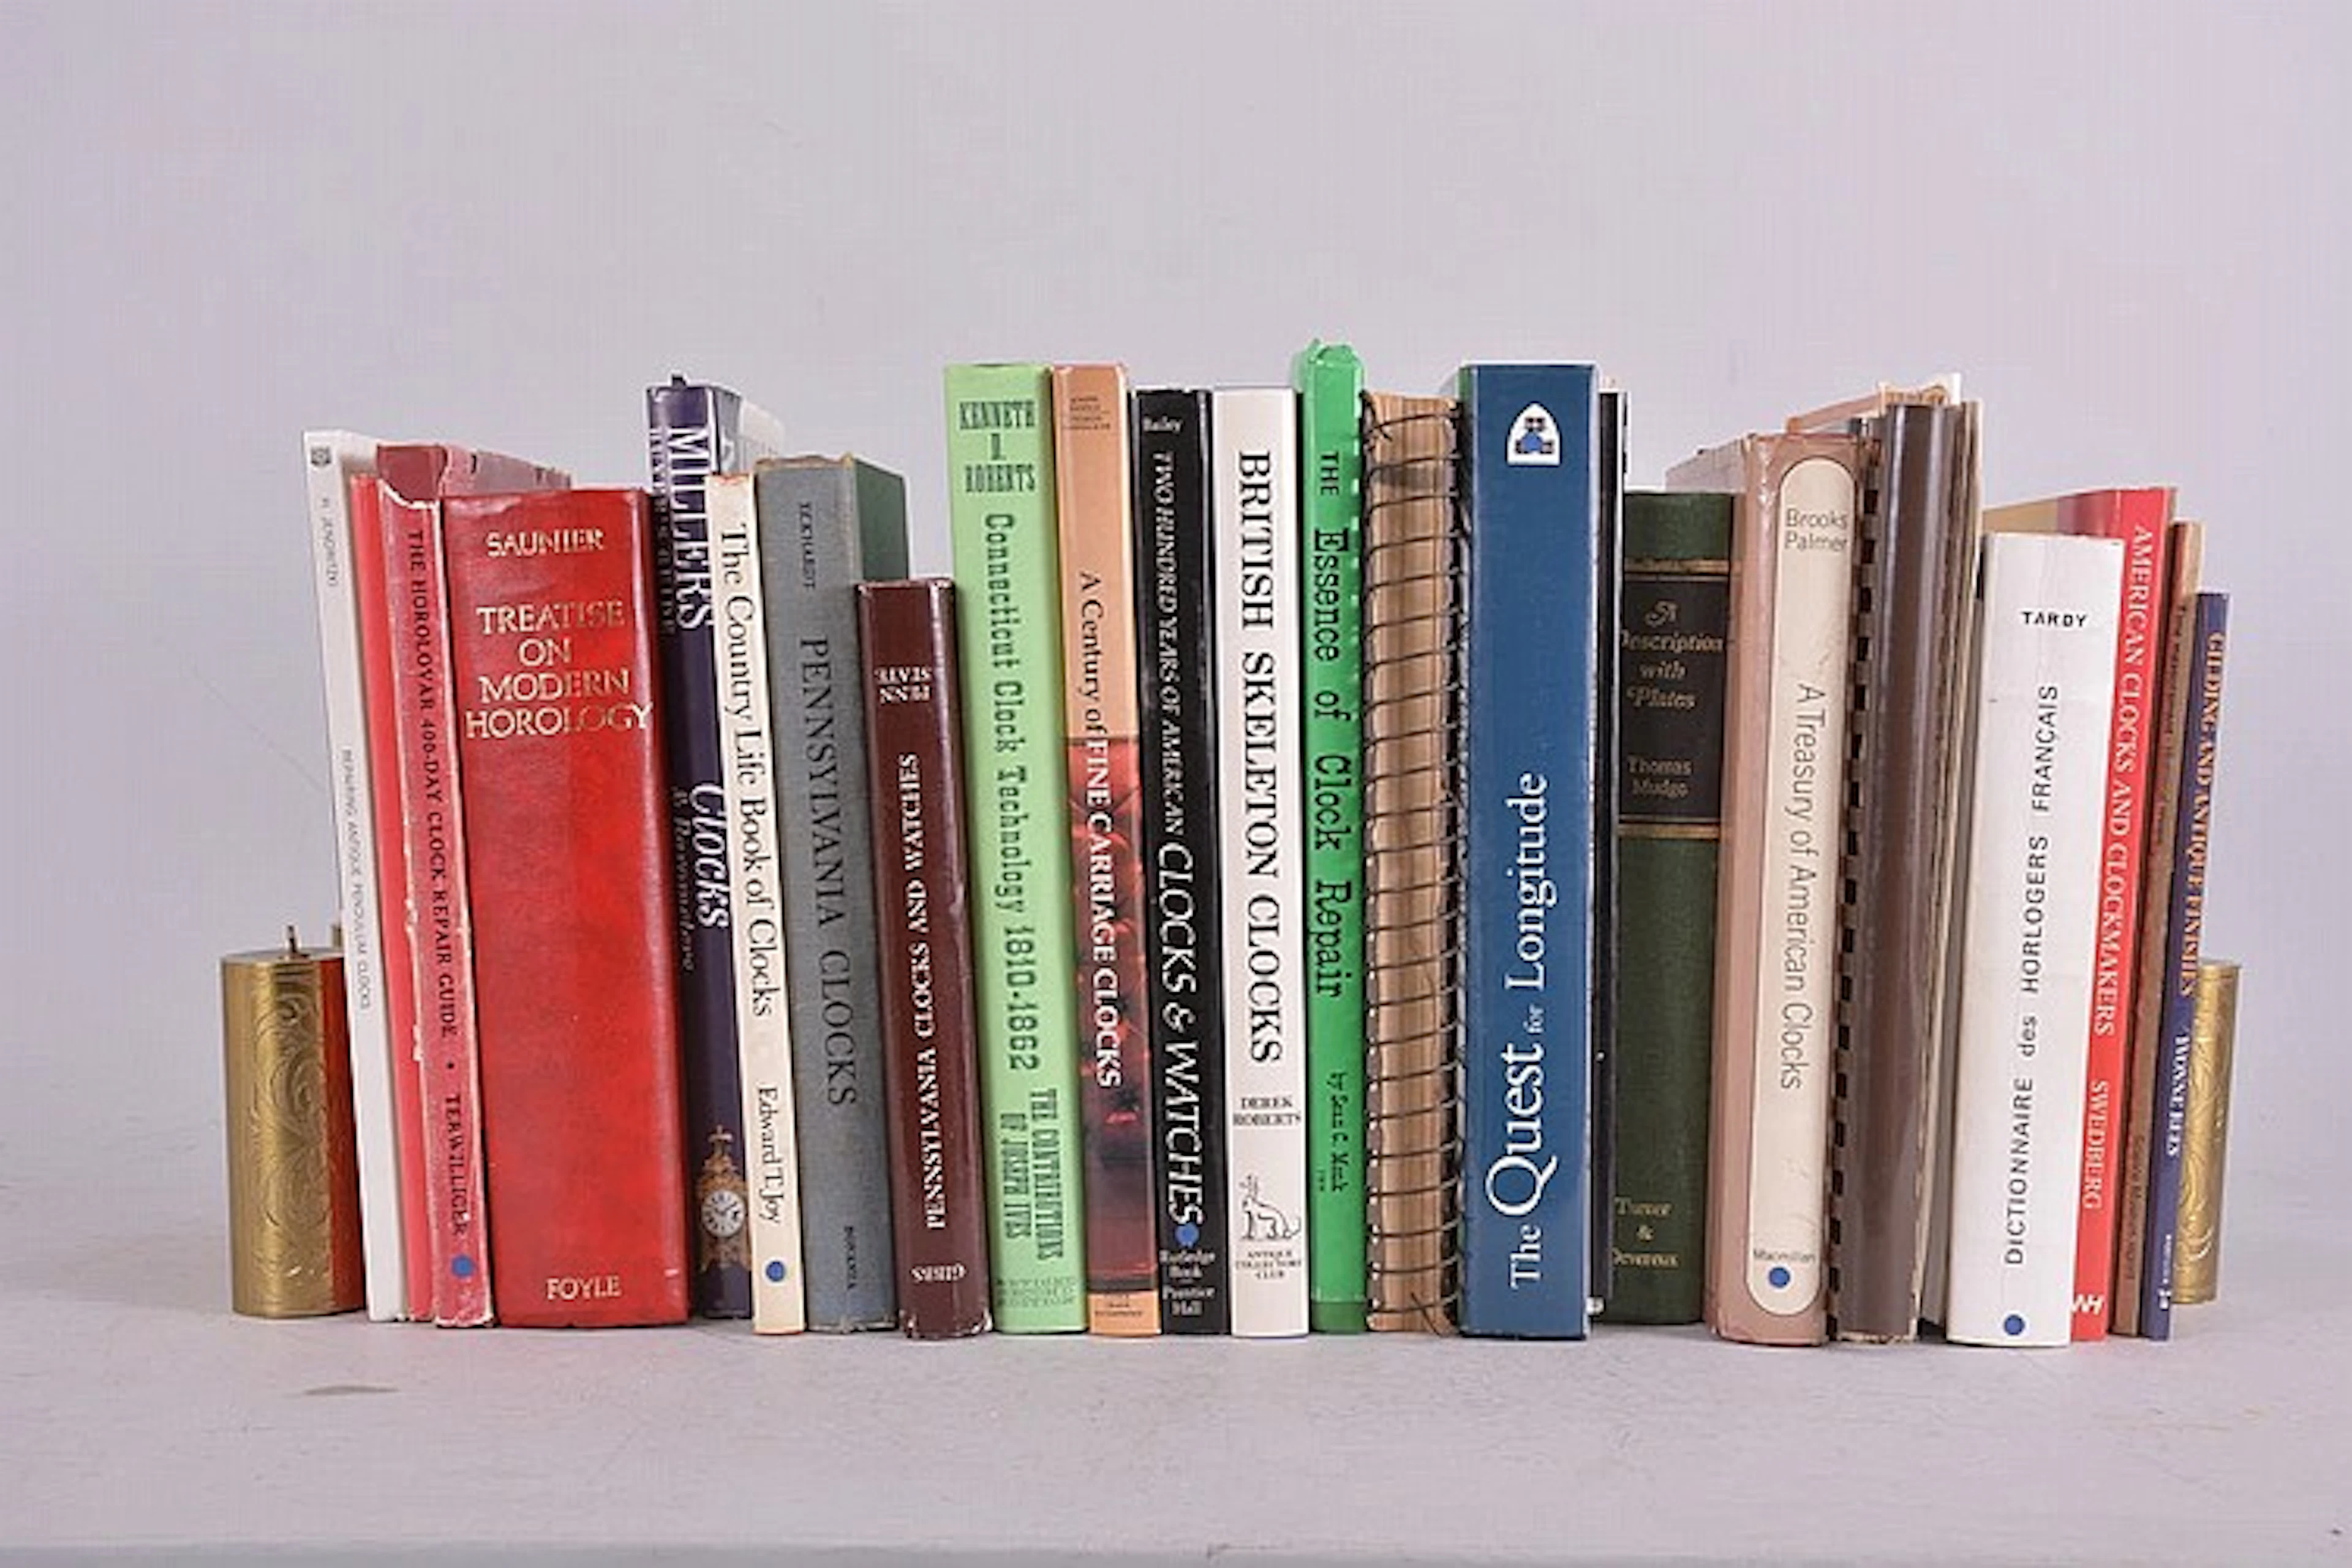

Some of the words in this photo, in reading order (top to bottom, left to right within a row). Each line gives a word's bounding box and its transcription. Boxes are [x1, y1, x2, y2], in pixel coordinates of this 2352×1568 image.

[965, 463, 1036, 492] ROBERTS
[1153, 451, 1175, 504] TWO
[1320, 451, 1340, 497] THE
[407, 529, 428, 571] THE
[486, 528, 605, 557] SAUNIER
[722, 523, 749, 584] The
[1238, 450, 1274, 631] BRITISH
[1785, 530, 1847, 552] Palmer
[1787, 507, 1848, 530] Brooks
[986, 513, 1022, 669] Connecticut
[1080, 571, 1104, 592] A
[1155, 507, 1178, 613] HUNDRED
[1314, 527, 1350, 663] Essence
[2123, 526, 2154, 666] AMERICAN
[410, 581, 437, 710] HOROLOVAR
[476, 600, 624, 635] TREATISE
[518, 638, 570, 666] ON
[1077, 598, 1105, 704] Century
[1158, 616, 1182, 684] YEARS
[2021, 611, 2087, 628] TARDY
[479, 669, 629, 705] MODERN
[725, 595, 756, 720] Country
[1796, 683, 1828, 703] A
[465, 703, 654, 739] HOROLOGY
[993, 680, 1027, 753] Clock
[1085, 708, 1107, 736] of
[1159, 685, 1183, 717] OF
[1315, 690, 1351, 722] of
[2114, 672, 2145, 774] CLOCKS
[734, 728, 766, 786] Life
[799, 638, 846, 929] PENNSYLVANIA
[1086, 739, 1112, 808] FINE
[1161, 719, 1184, 834] AMERICAN
[1242, 650, 1279, 880] SKELETON
[1784, 709, 1826, 823] Treasury
[2032, 685, 2060, 813] FRANÇAIS
[740, 798, 771, 873] Book
[897, 753, 924, 871] WATCHES
[995, 765, 1033, 914] Technology
[1314, 753, 1352, 851] Clock
[2108, 778, 2135, 835] AND
[427, 812, 447, 881] CLOCK
[1504, 772, 1558, 992] Longitude
[1789, 831, 1820, 857] of
[746, 878, 775, 911] of
[904, 878, 929, 933] AND
[1088, 812, 1118, 963] CARRIAGE
[1158, 842, 1197, 994] CLOCKS
[2020, 835, 2049, 995] HORLOGERS
[432, 890, 452, 966] REPAIR
[1311, 880, 1352, 998] Repair
[1784, 865, 1817, 992] American
[2094, 842, 2129, 1038] CLOCKMAKERS
[439, 973, 458, 1038] GUIDE
[748, 918, 781, 1017] Clocks
[908, 941, 935, 1039] CLOCKS
[1248, 894, 1283, 1065] CLOCKS
[818, 949, 857, 1106] CLOCKS
[1093, 967, 1123, 1088] CLOCKS
[1163, 1001, 1195, 1035] &
[1523, 1003, 1544, 1035] for
[1780, 1002, 1814, 1090] Clocks
[2017, 1016, 2038, 1058] des
[758, 1086, 782, 1164] Edward
[918, 1045, 947, 1230] PENNSYLVANIA
[1164, 1041, 1204, 1225] WATCHES
[1484, 1042, 1558, 1218] Quest
[445, 1095, 470, 1236] TERWILLIGER
[2004, 1079, 2034, 1266] DICTIONNAIRE
[758, 1188, 785, 1224] Joy
[545, 1276, 622, 1300] FOYLE
[1509, 1224, 1543, 1289] The
